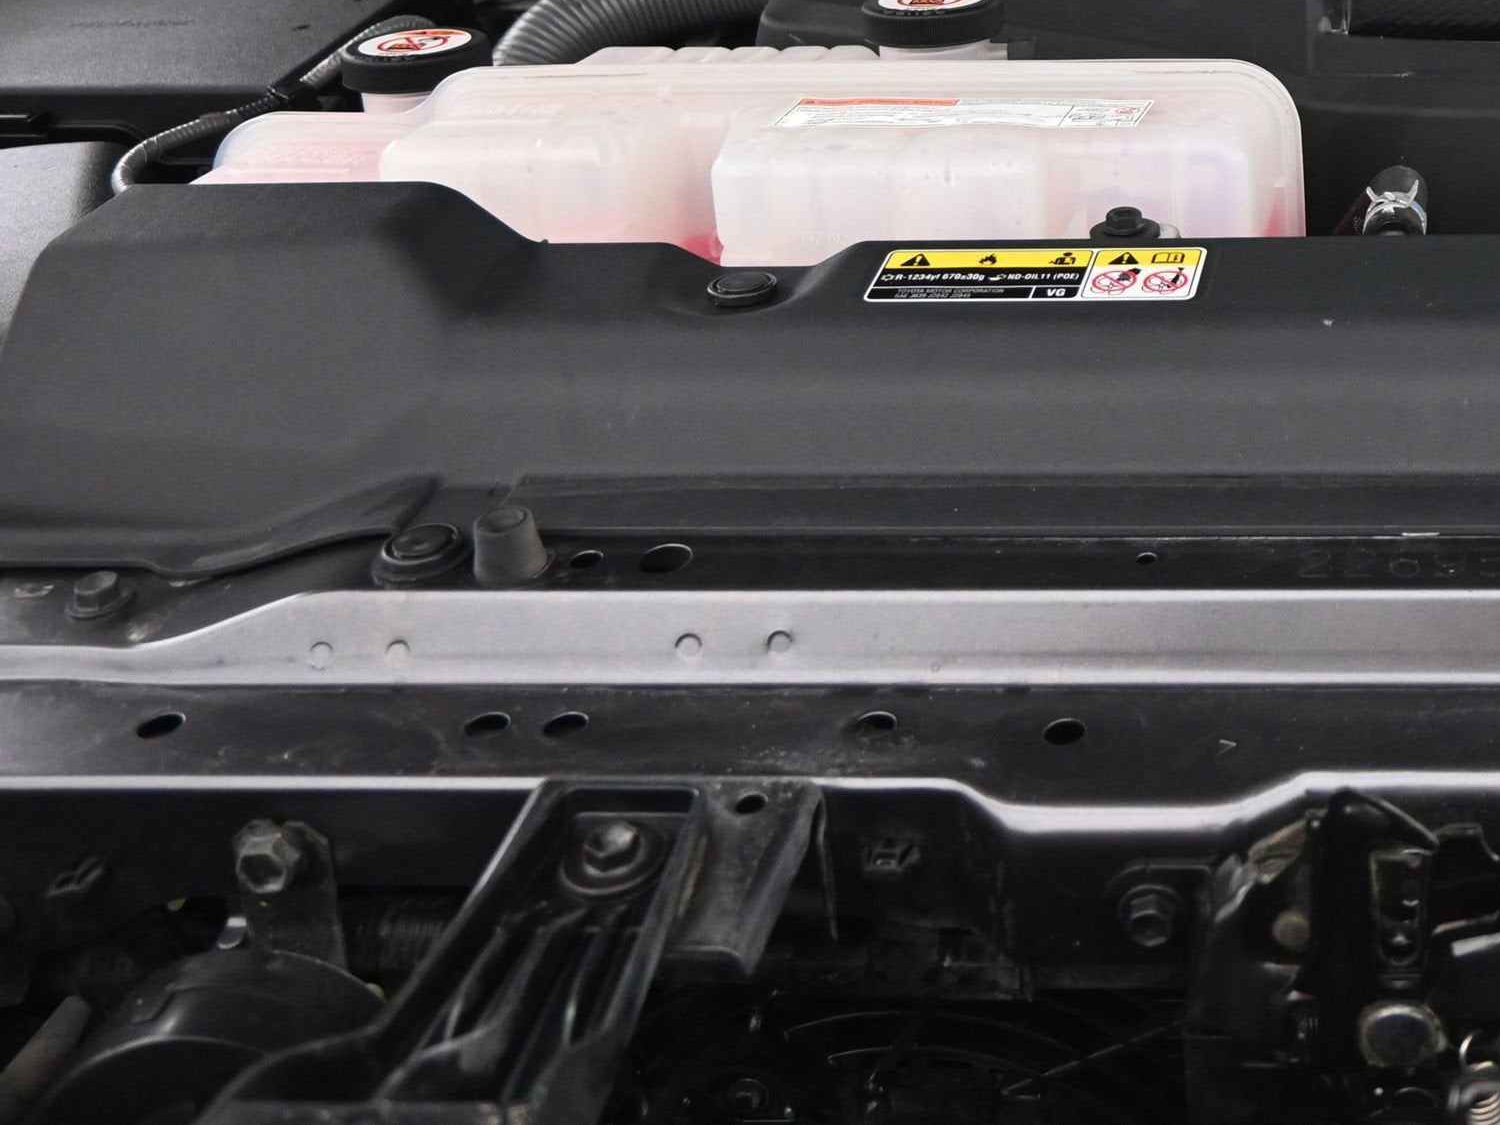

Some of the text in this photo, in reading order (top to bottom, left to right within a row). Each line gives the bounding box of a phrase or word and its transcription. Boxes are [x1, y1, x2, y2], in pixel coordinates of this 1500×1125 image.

[895, 273, 940, 281] R-1234yf
[942, 273, 985, 281] 670±30g
[1053, 273, 1079, 281] (POE)
[1046, 288, 1066, 297] VG
